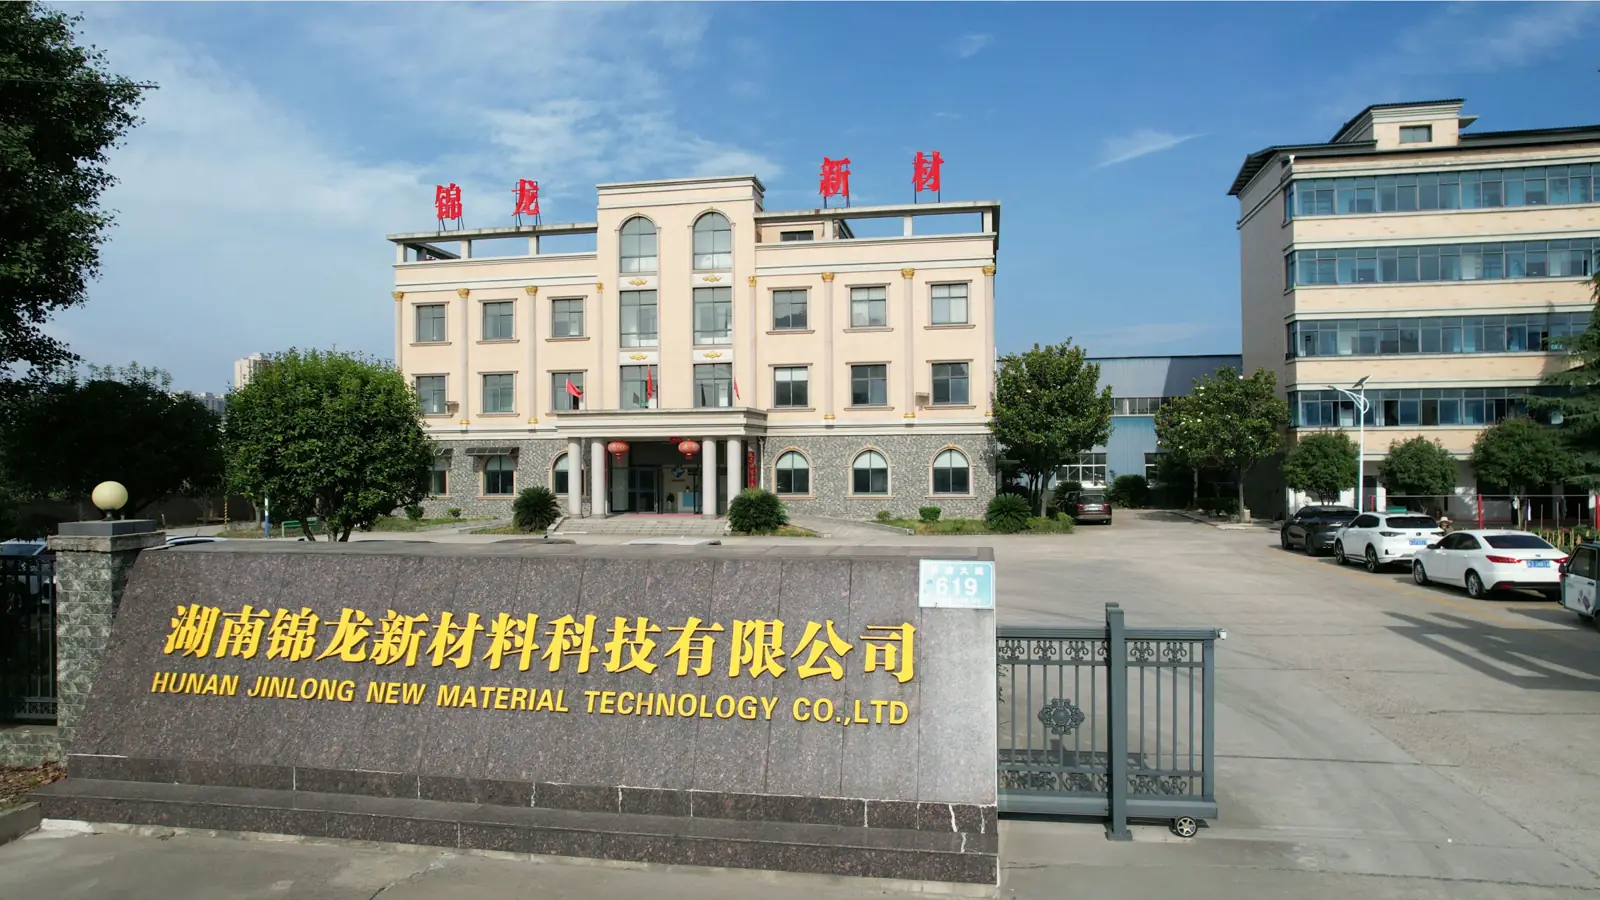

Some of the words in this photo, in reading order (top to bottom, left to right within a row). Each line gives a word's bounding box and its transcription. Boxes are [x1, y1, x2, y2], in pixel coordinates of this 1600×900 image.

[819, 151, 944, 198] 新材
[936, 577, 978, 597] 619
[163, 603, 916, 683] 湖南锦龙新材料科技有限公司
[151, 672, 240, 697] HUNAN
[247, 676, 356, 702] JINLONG
[366, 681, 427, 706] NEW
[436, 684, 570, 713] MATERIAL
[585, 690, 779, 721] TECHNOLOGY
[792, 697, 910, 726] CO.,LTD
